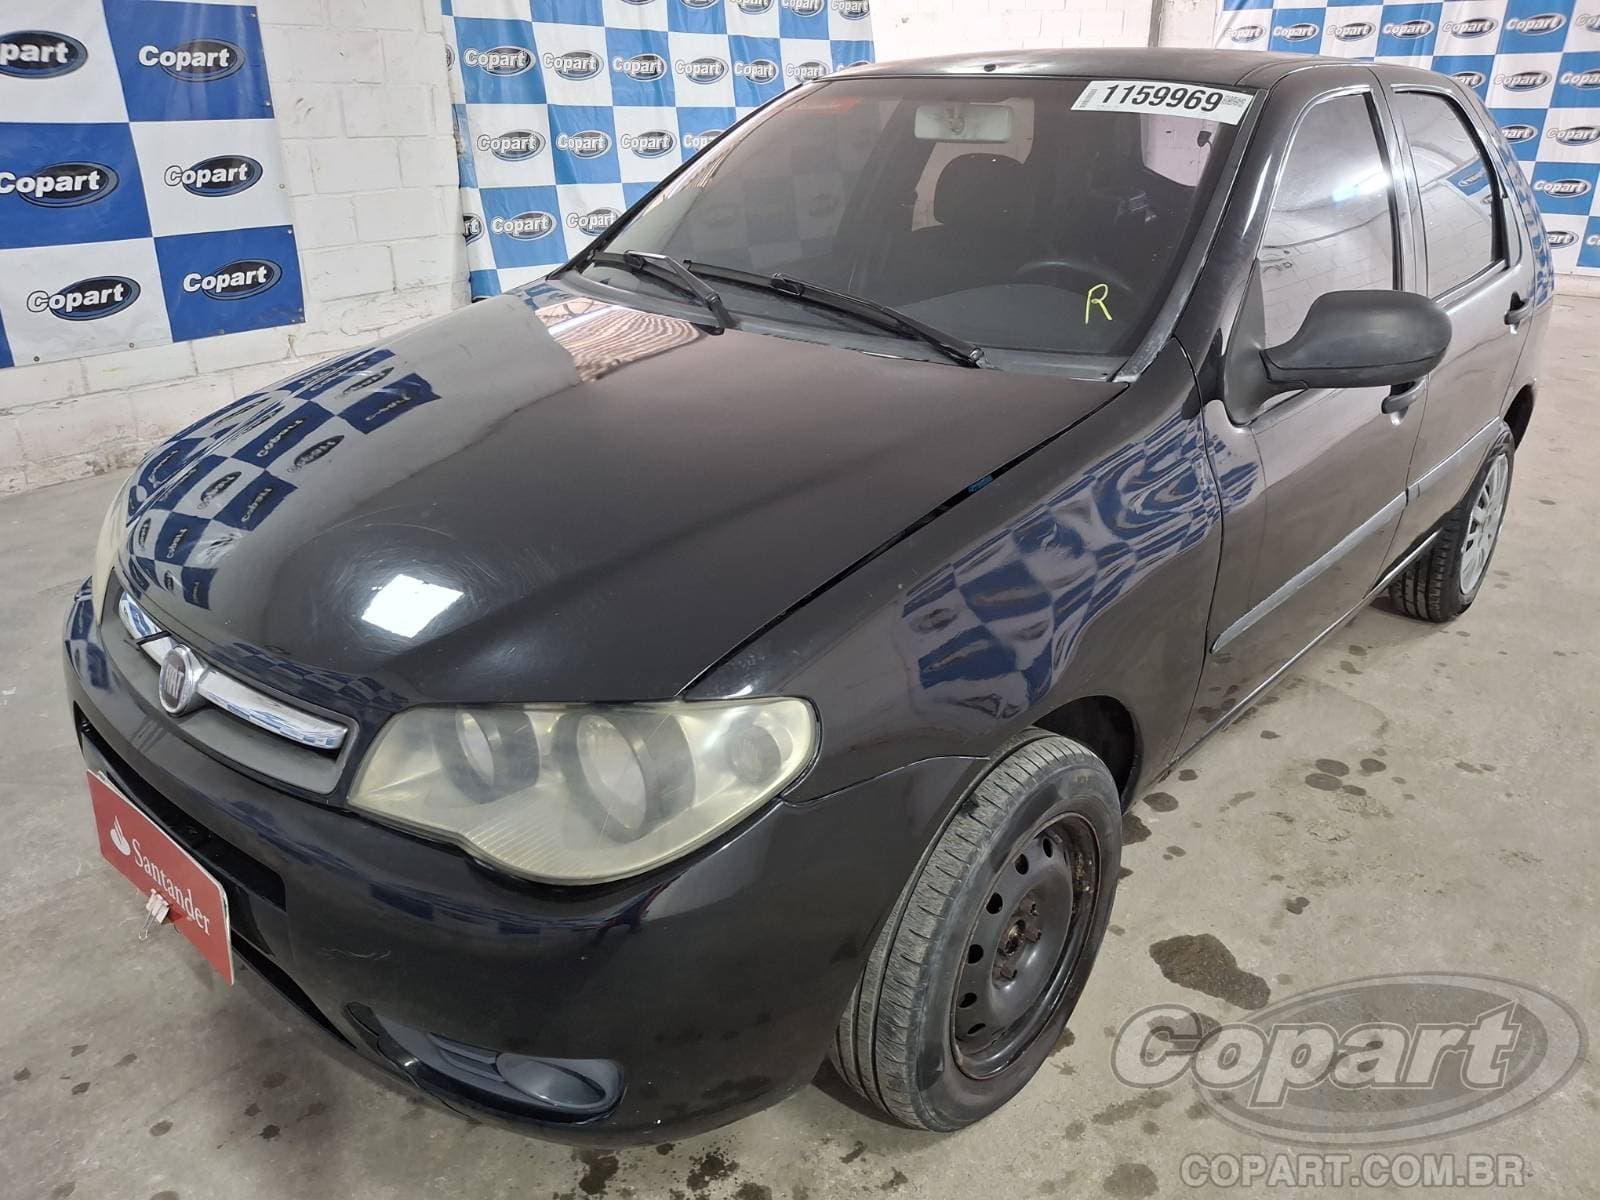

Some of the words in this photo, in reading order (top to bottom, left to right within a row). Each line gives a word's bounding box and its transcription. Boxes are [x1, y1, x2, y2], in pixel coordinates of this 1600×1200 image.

[831, 0, 869, 12] Copart
[1225, 25, 1260, 38] Copart
[1273, 25, 1314, 37] Copart
[1328, 24, 1369, 37] Copart
[1383, 22, 1427, 36] Copart
[1443, 20, 1491, 35] Copart
[1506, 15, 1561, 33] Copart
[0, 42, 68, 64] part
[138, 45, 230, 70] Copart
[464, 48, 527, 71] Copart
[543, 53, 597, 71] Copart
[612, 57, 662, 73] Copart
[675, 59, 722, 78] Copart
[734, 62, 774, 77] Copart
[786, 63, 824, 79] Copart
[1495, 72, 1546, 88] Copart
[1102, 84, 1223, 112] 1159969
[477, 134, 536, 154] Copart
[556, 133, 604, 152] Copart
[621, 133, 671, 151] Copart
[1547, 128, 1599, 142] Copart
[0, 170, 101, 198] Copart
[164, 163, 249, 189] Copart
[1533, 179, 1586, 193] Copart
[490, 214, 550, 236] Copart
[182, 265, 270, 293] Copart
[26, 281, 126, 314] Copart
[1085, 283, 1112, 324] R
[131, 838, 211, 937] Santander
